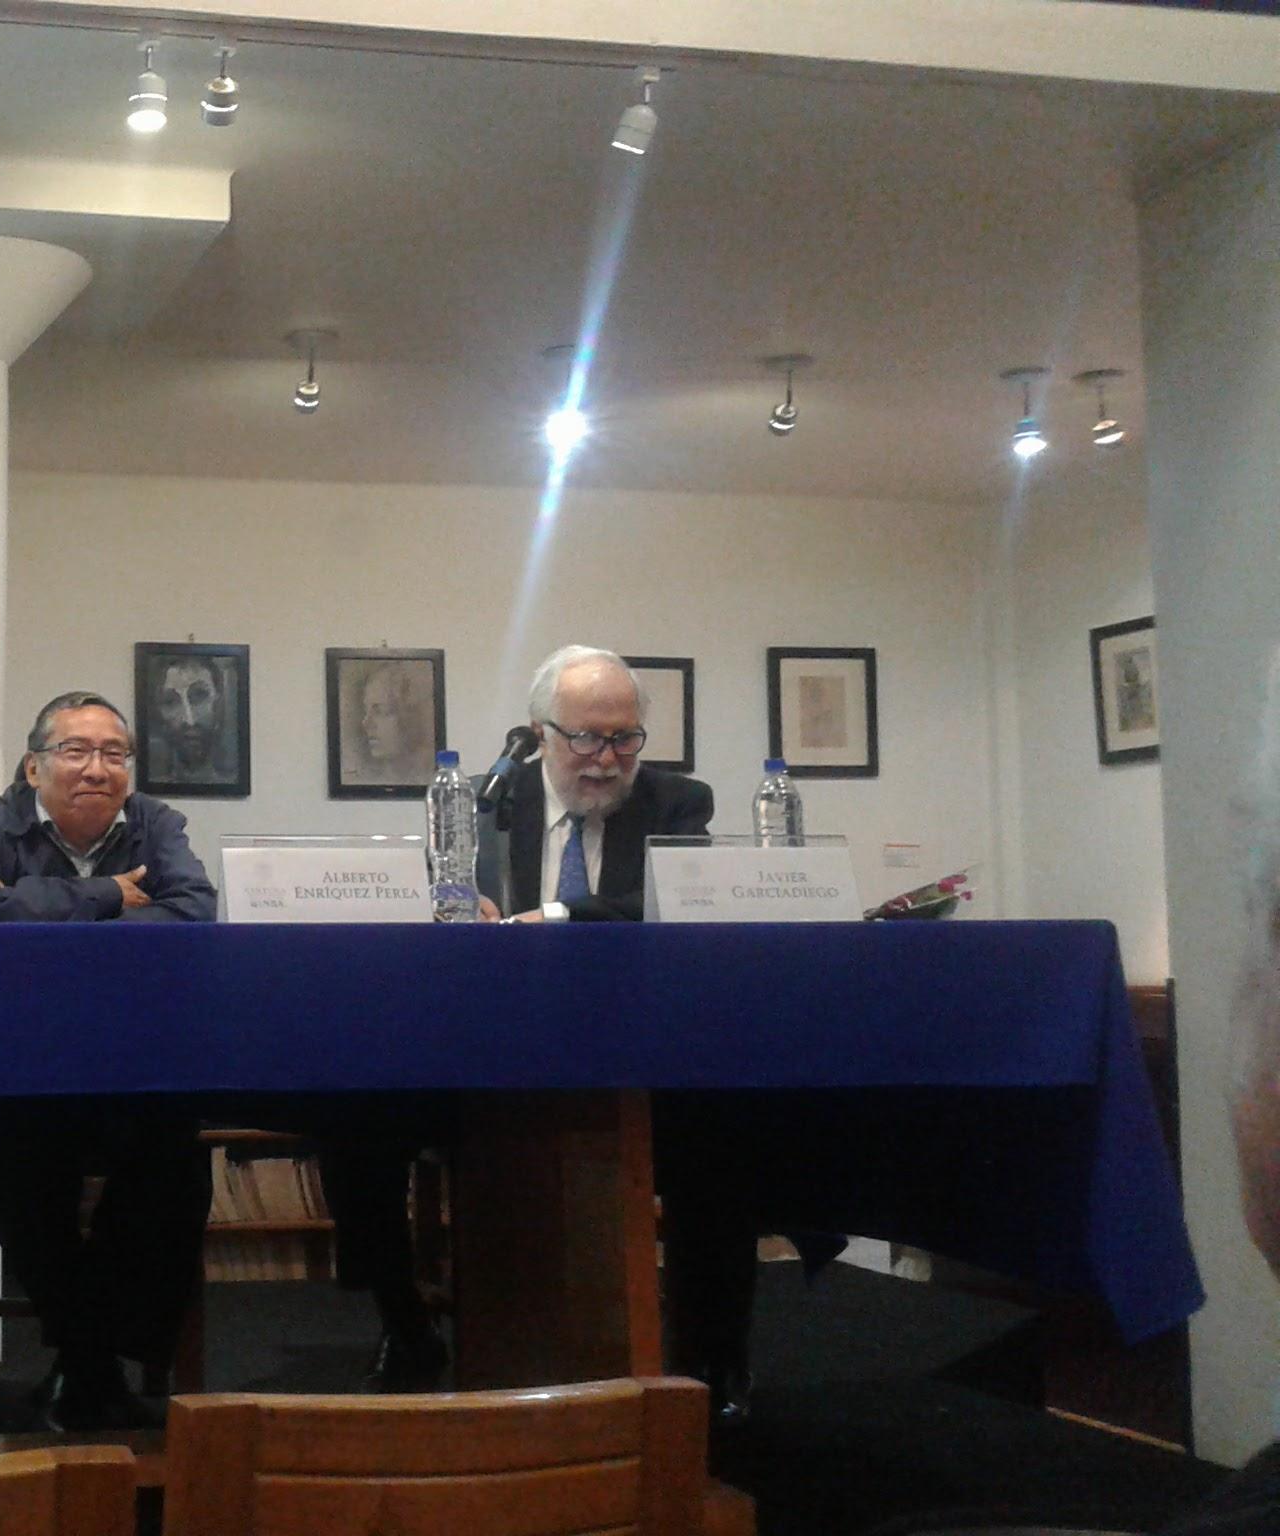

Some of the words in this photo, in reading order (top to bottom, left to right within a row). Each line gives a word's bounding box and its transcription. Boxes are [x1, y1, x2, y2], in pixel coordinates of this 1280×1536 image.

[322, 871, 389, 884] ALBERTO
[757, 870, 807, 883] JAVIER
[375, 886, 420, 899] PEREA
[731, 885, 839, 899] GARCIADIEGO
